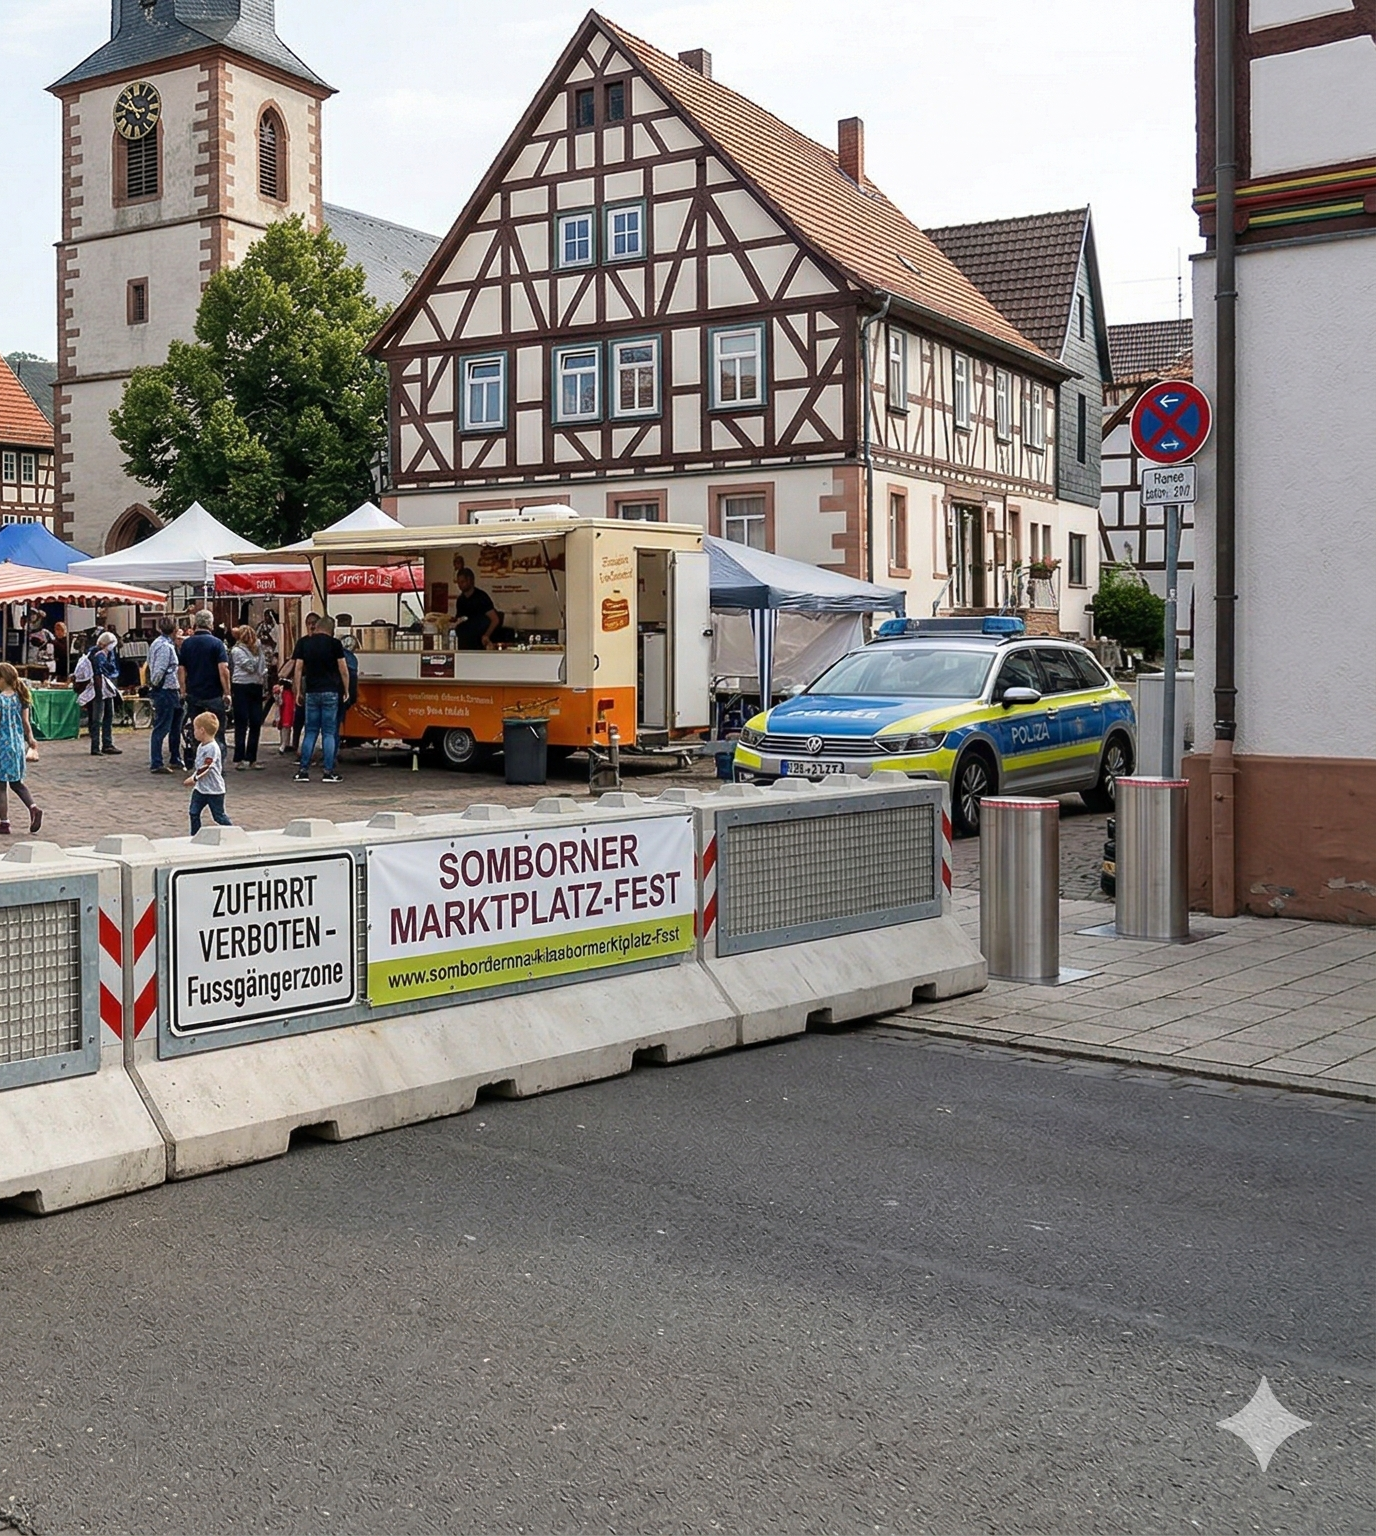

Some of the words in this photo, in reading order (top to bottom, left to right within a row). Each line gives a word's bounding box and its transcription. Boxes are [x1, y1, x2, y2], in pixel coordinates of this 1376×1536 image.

[439, 834, 640, 890] SOMBORNER
[212, 874, 318, 918] ZUFHRRT
[390, 871, 681, 945] MARKTPLATZ-FEST
[188, 962, 344, 1008] Fussgängerzone
